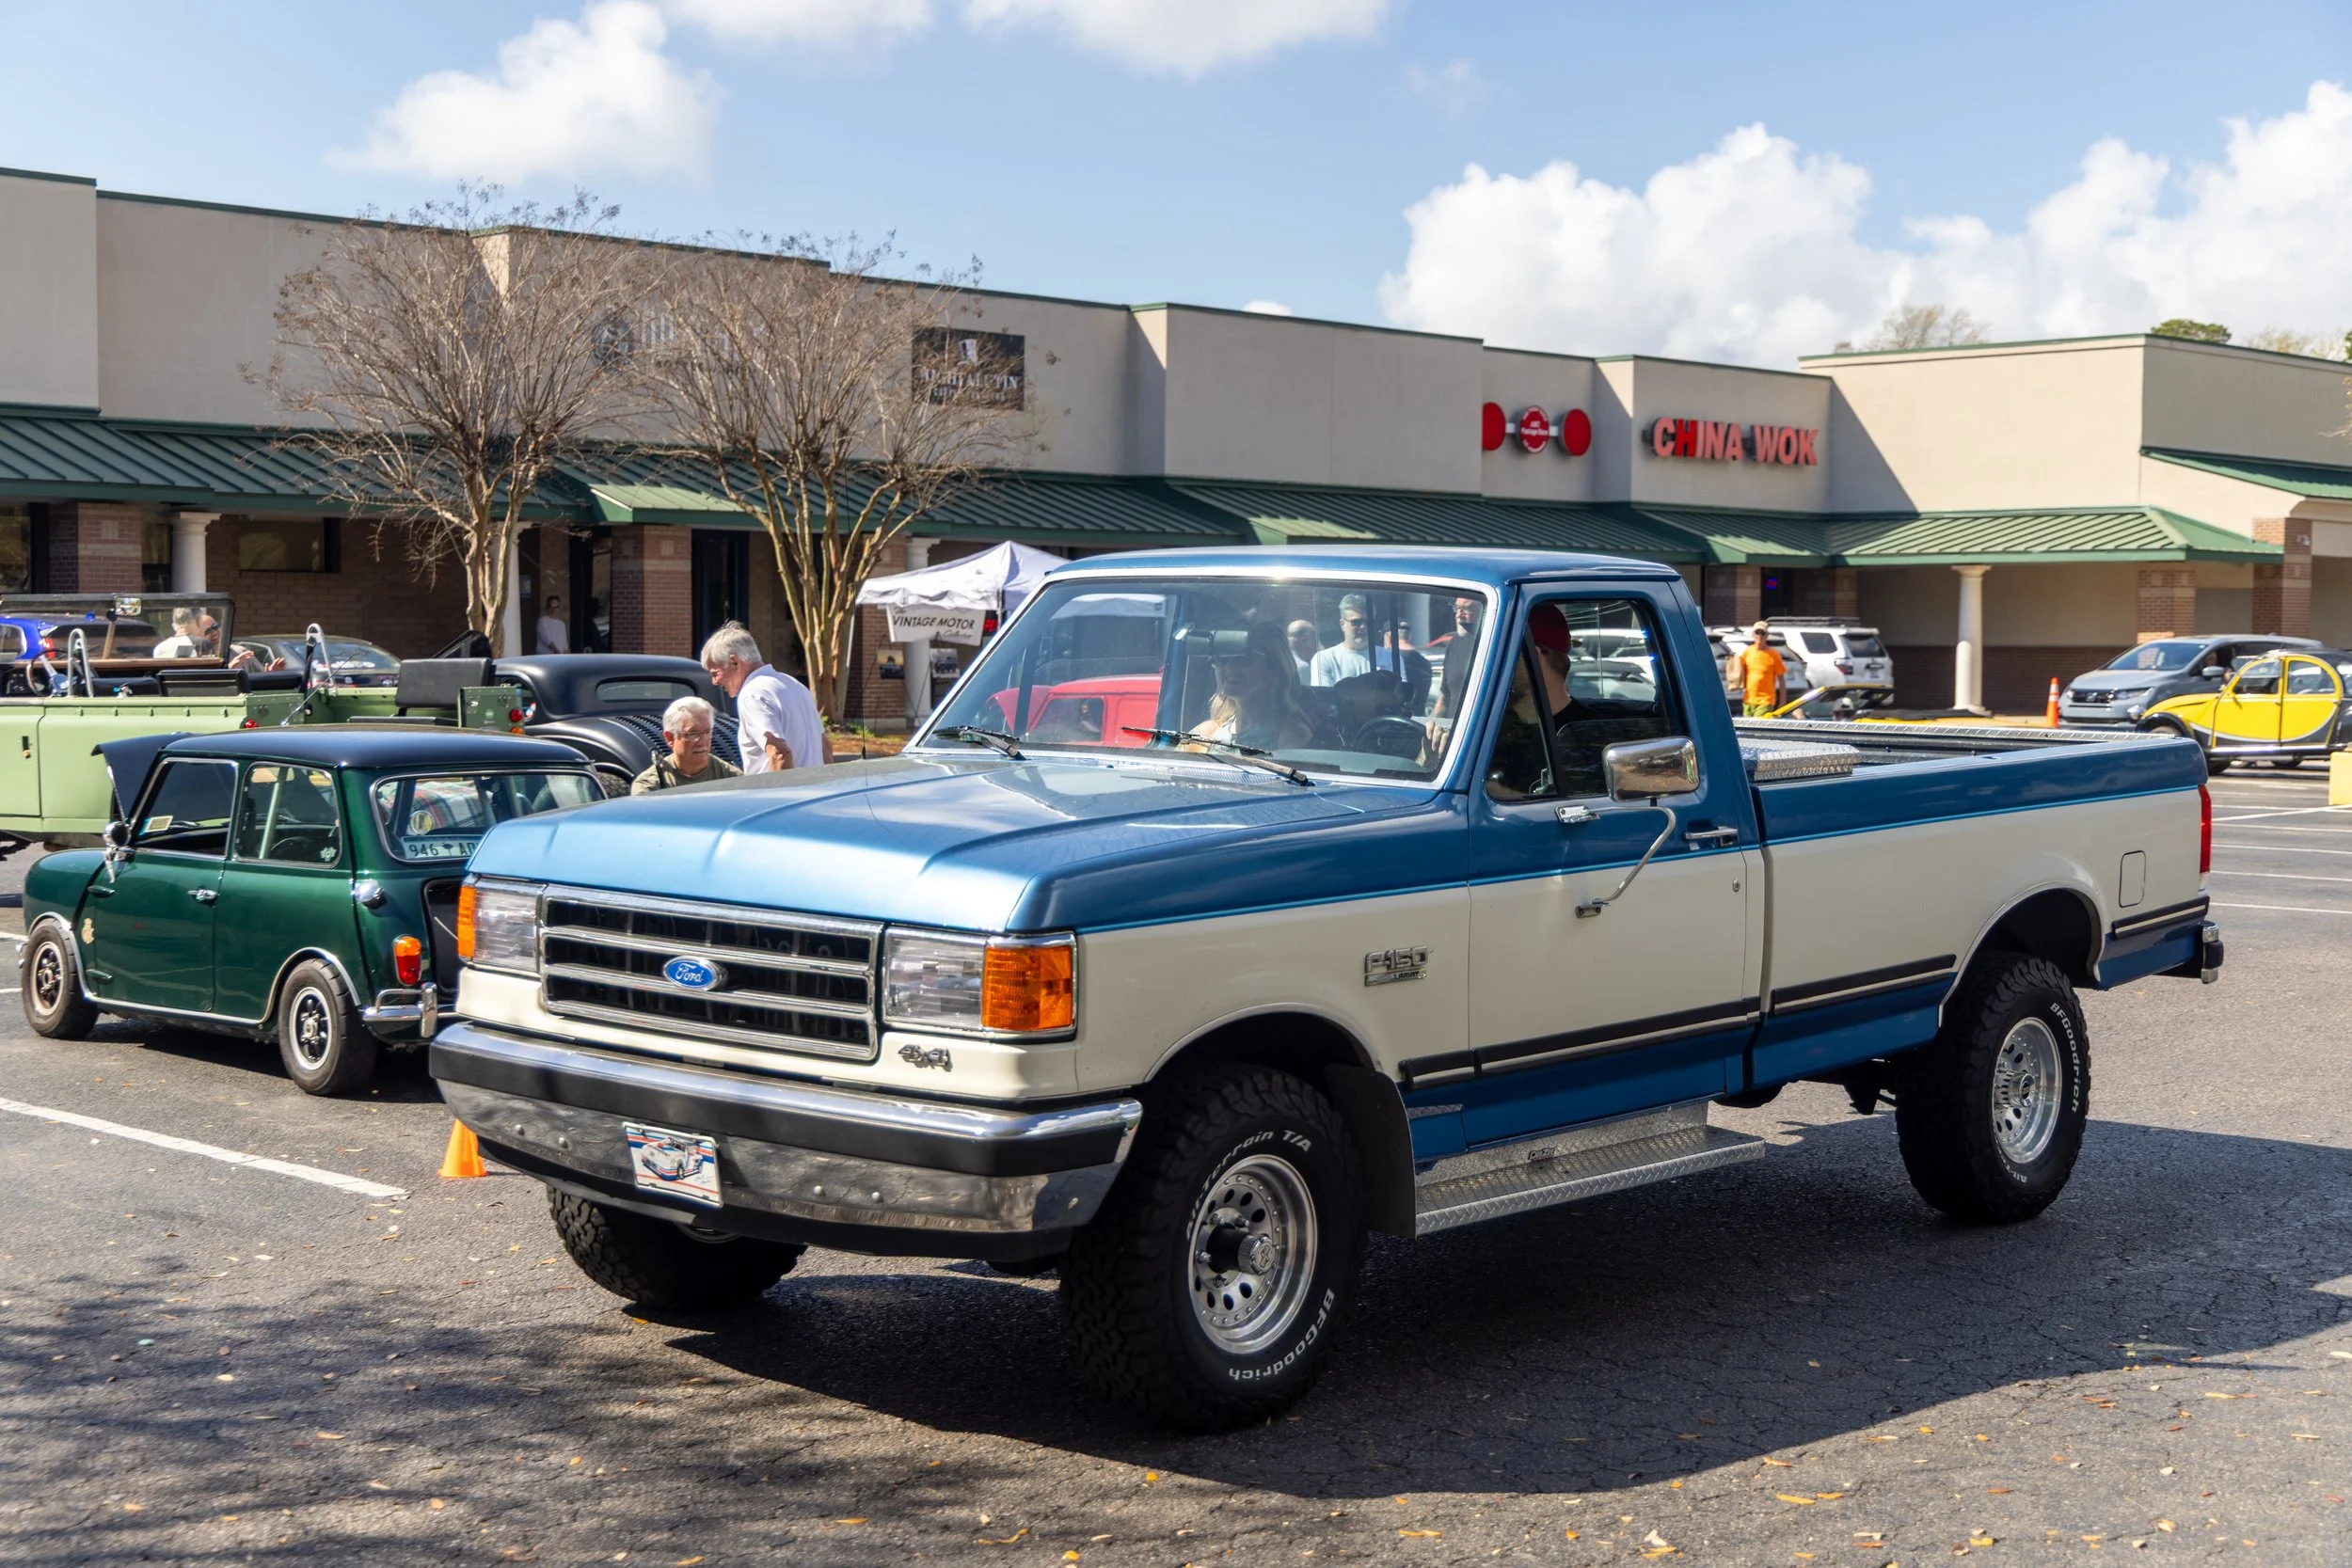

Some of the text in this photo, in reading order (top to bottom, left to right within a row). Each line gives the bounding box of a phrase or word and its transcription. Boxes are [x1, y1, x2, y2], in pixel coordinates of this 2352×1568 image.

[1653, 416, 1818, 467] CHINA WOK
[893, 614, 937, 628] VINTAGE
[936, 618, 976, 630] MOTOR
[408, 843, 439, 857] 946
[675, 961, 705, 984] Ford
[2049, 1003, 2081, 1114] BFGoodrich
[1281, 1130, 1312, 1152] T/A
[1228, 1288, 1335, 1381] BFGoodrich
